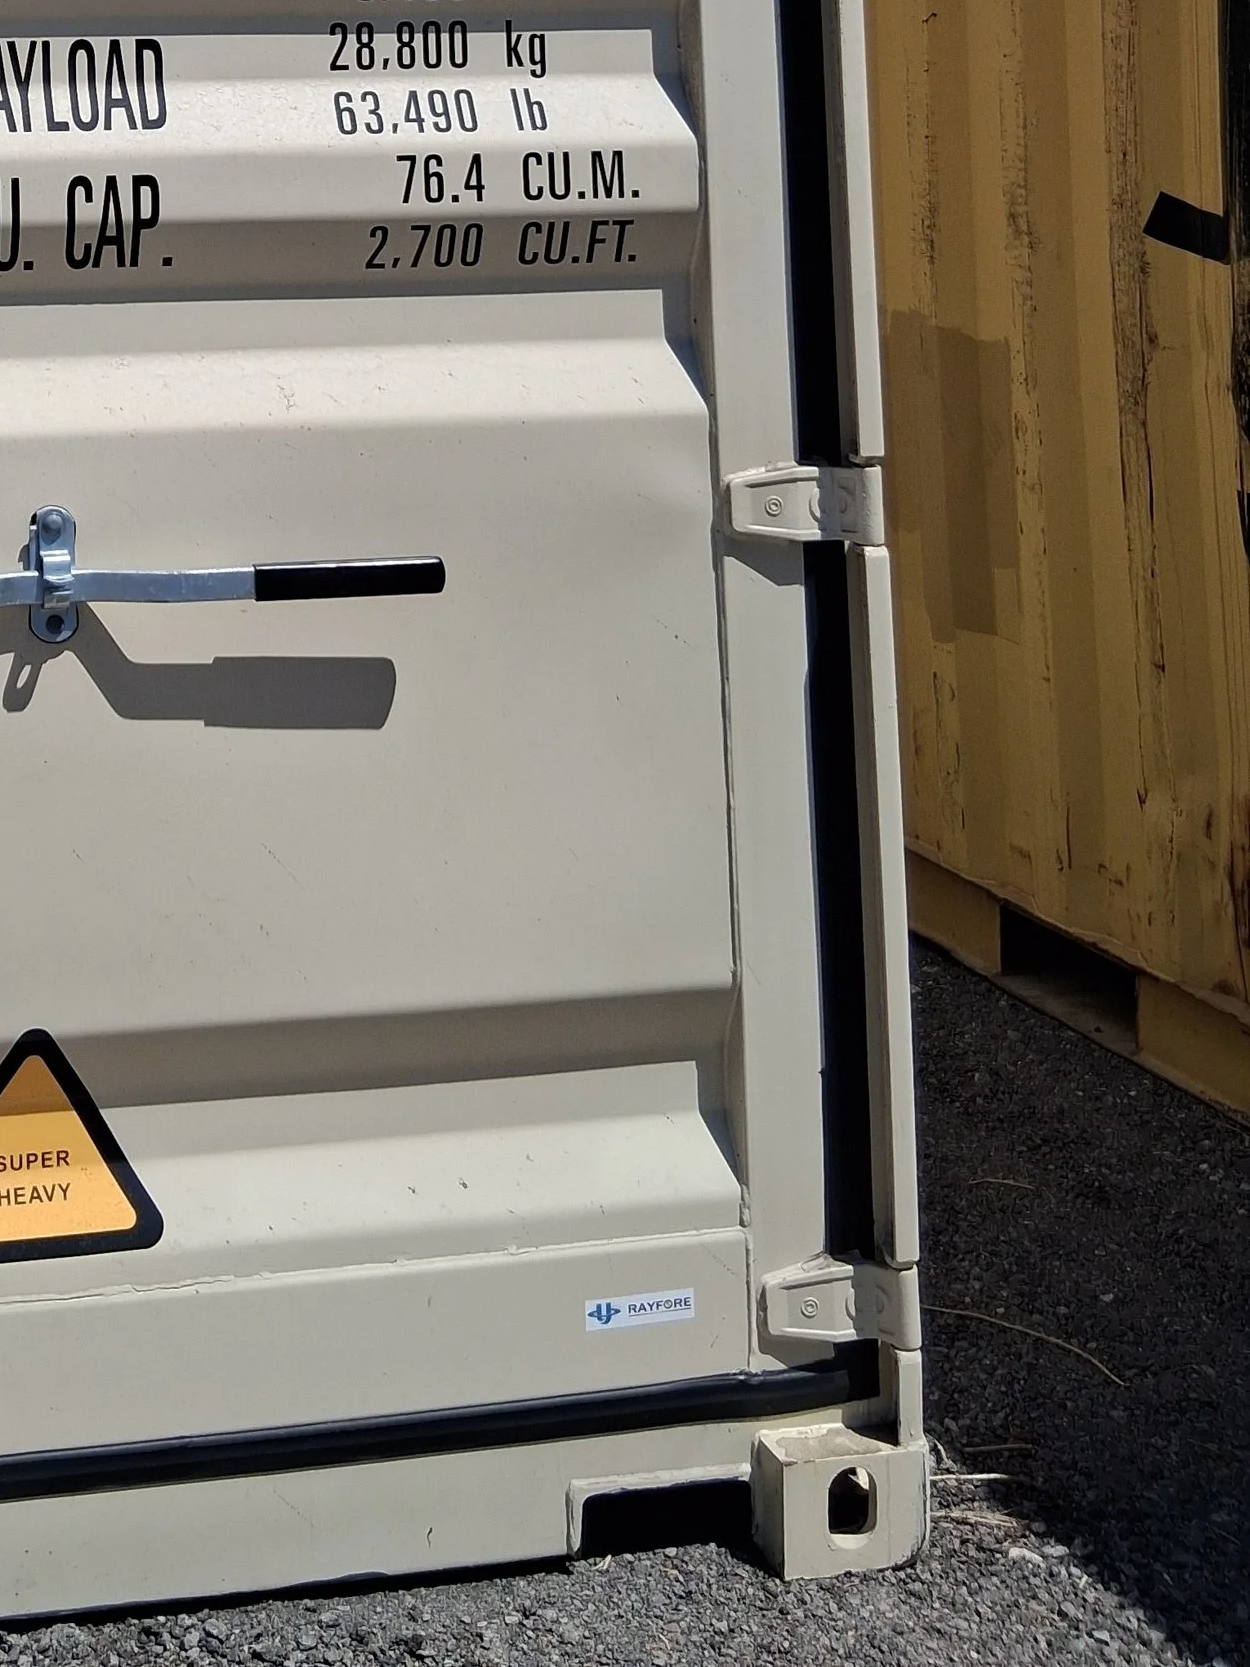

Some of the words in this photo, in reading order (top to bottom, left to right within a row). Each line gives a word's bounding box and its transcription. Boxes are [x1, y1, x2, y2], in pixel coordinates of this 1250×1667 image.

[328, 19, 469, 72] 28,800
[504, 19, 547, 79] kg
[333, 88, 479, 136] 63,490
[509, 87, 548, 132] lb
[64, 173, 174, 270] CAP.
[395, 152, 486, 204] 76.4
[522, 149, 640, 202] CU.M.
[364, 222, 484, 270] 2,700
[517, 218, 637, 266] CU.FT.
[628, 1296, 692, 1314] RAYFORE
